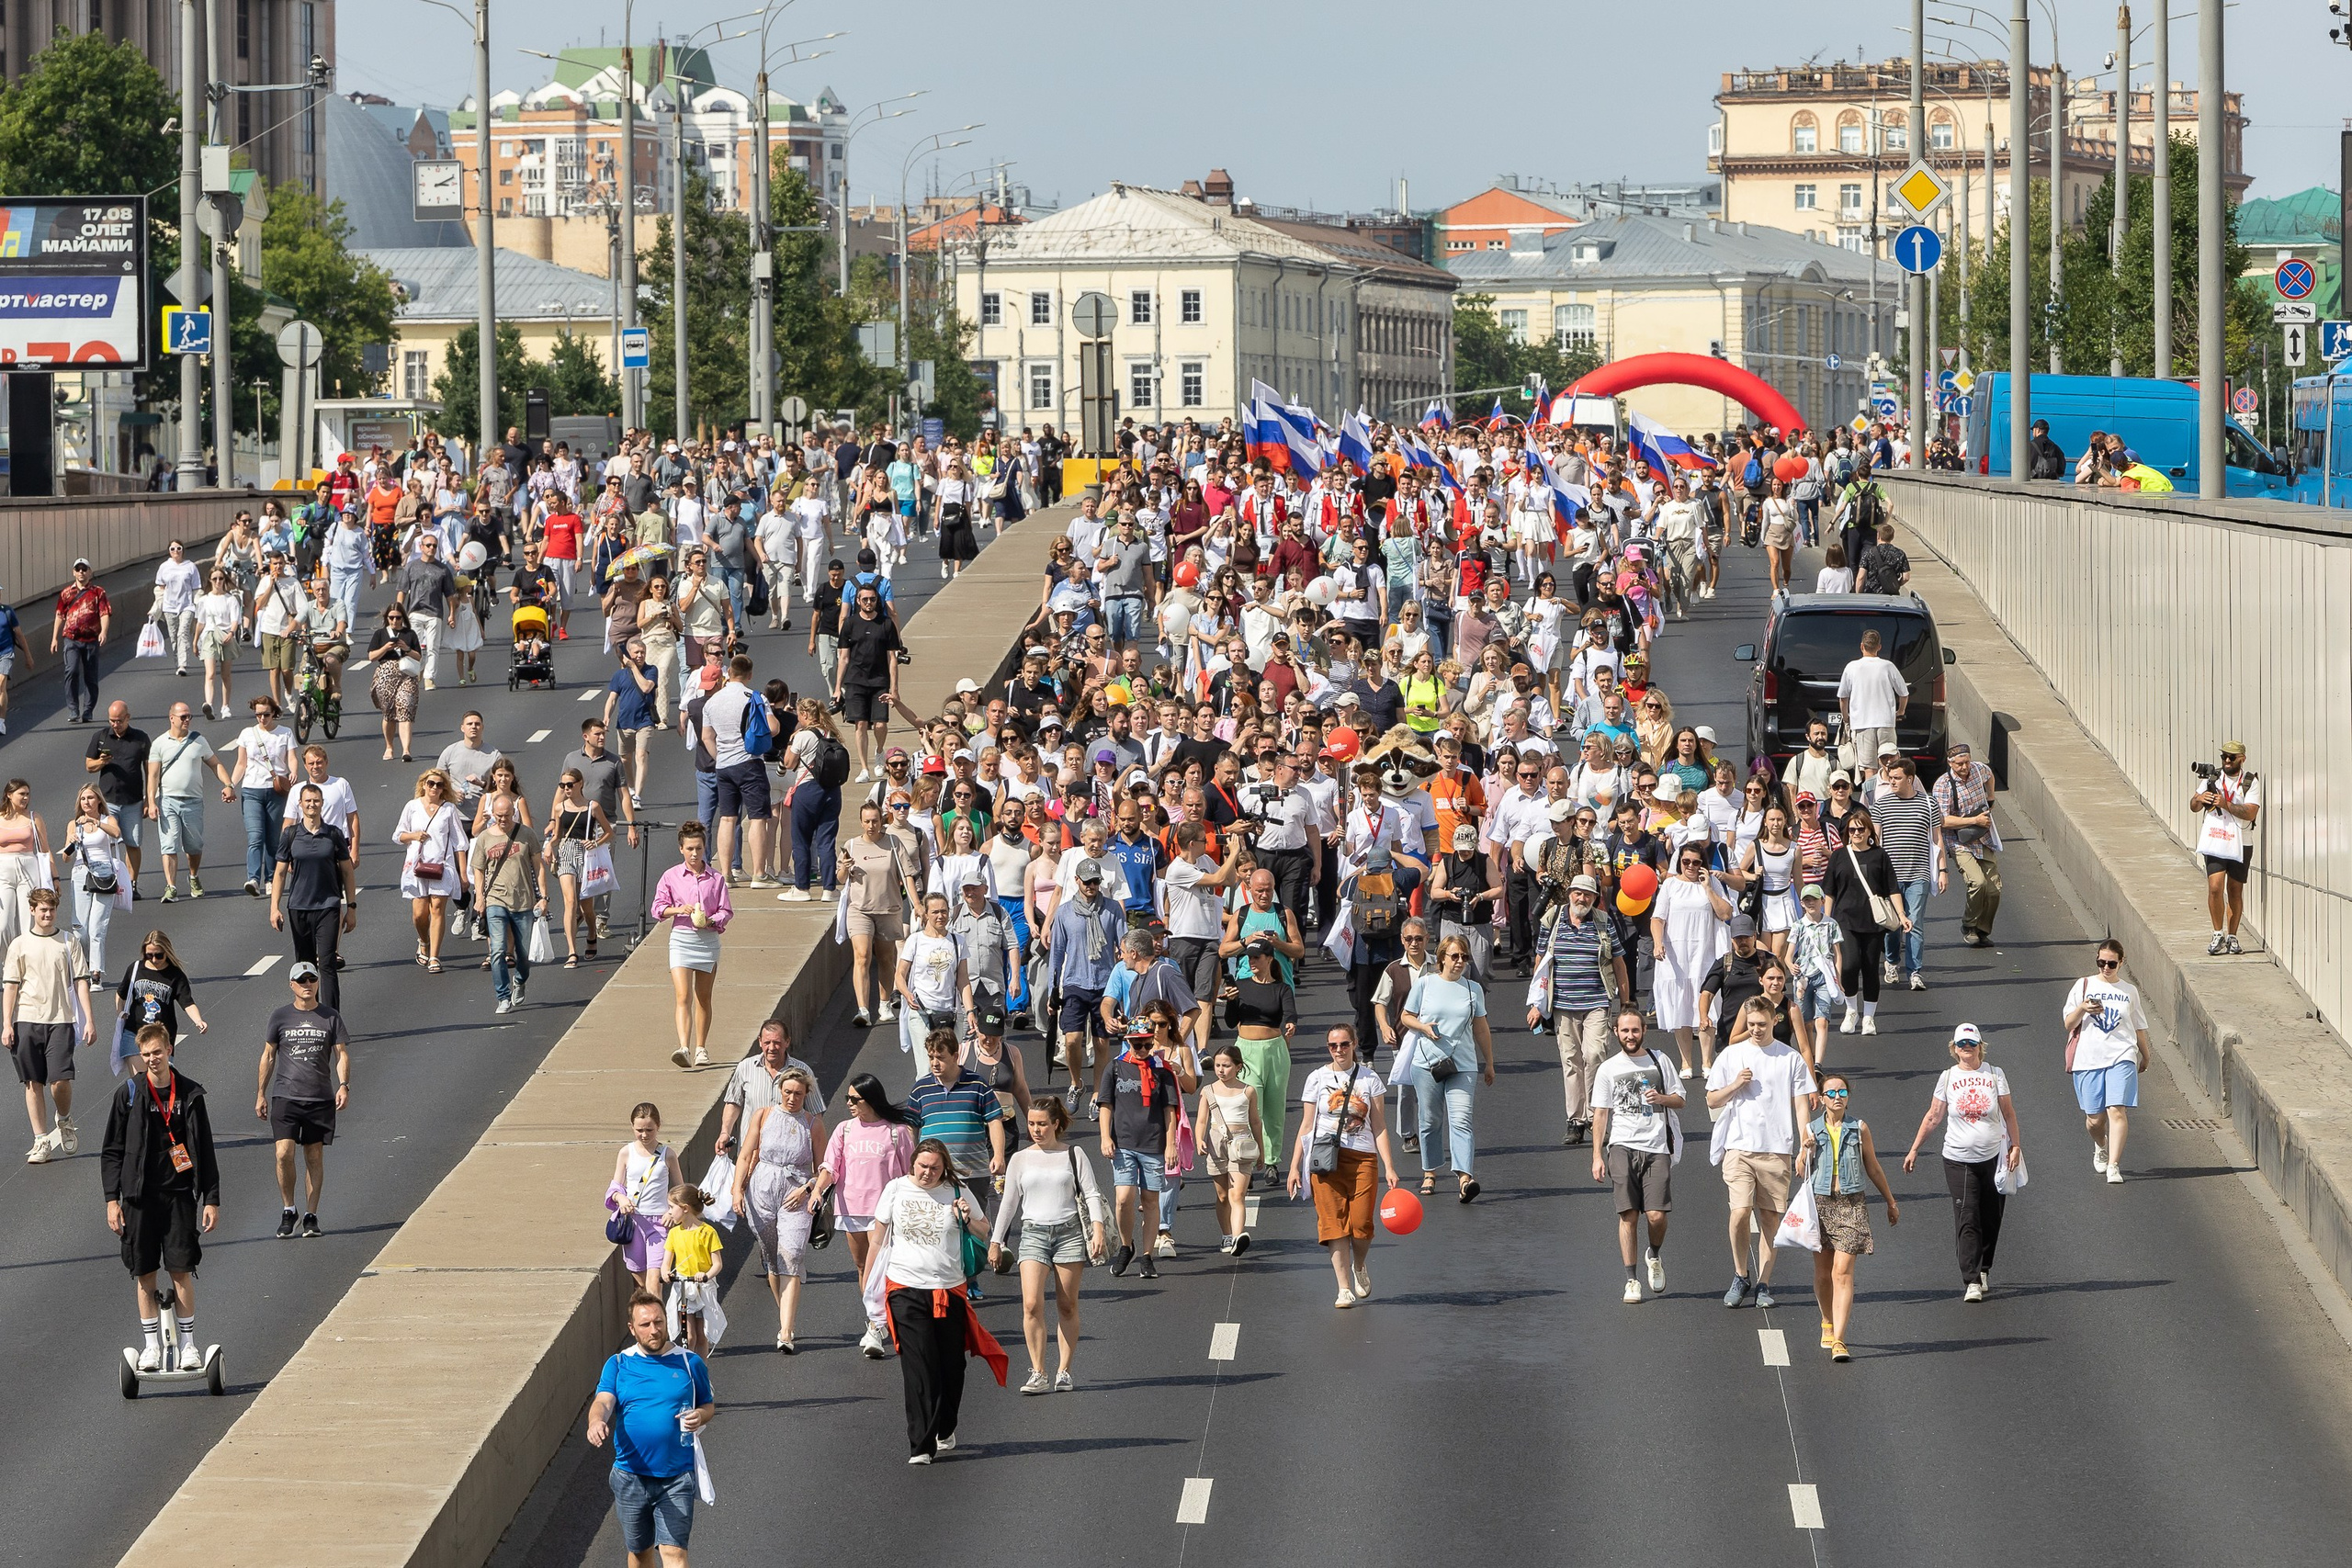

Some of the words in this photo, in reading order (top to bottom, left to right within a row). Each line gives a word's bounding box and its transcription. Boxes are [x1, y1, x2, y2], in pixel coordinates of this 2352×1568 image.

[83, 207, 133, 221] 17.08
[81, 223, 133, 237] ОЛЕГ
[41, 235, 133, 253] МАЙАМИ
[2086, 993, 2130, 1004] OCEANIA
[285, 1028, 326, 1038] PROTEST
[1951, 1077, 1994, 1092] RUSSIA
[847, 1139, 886, 1157] NIKE
